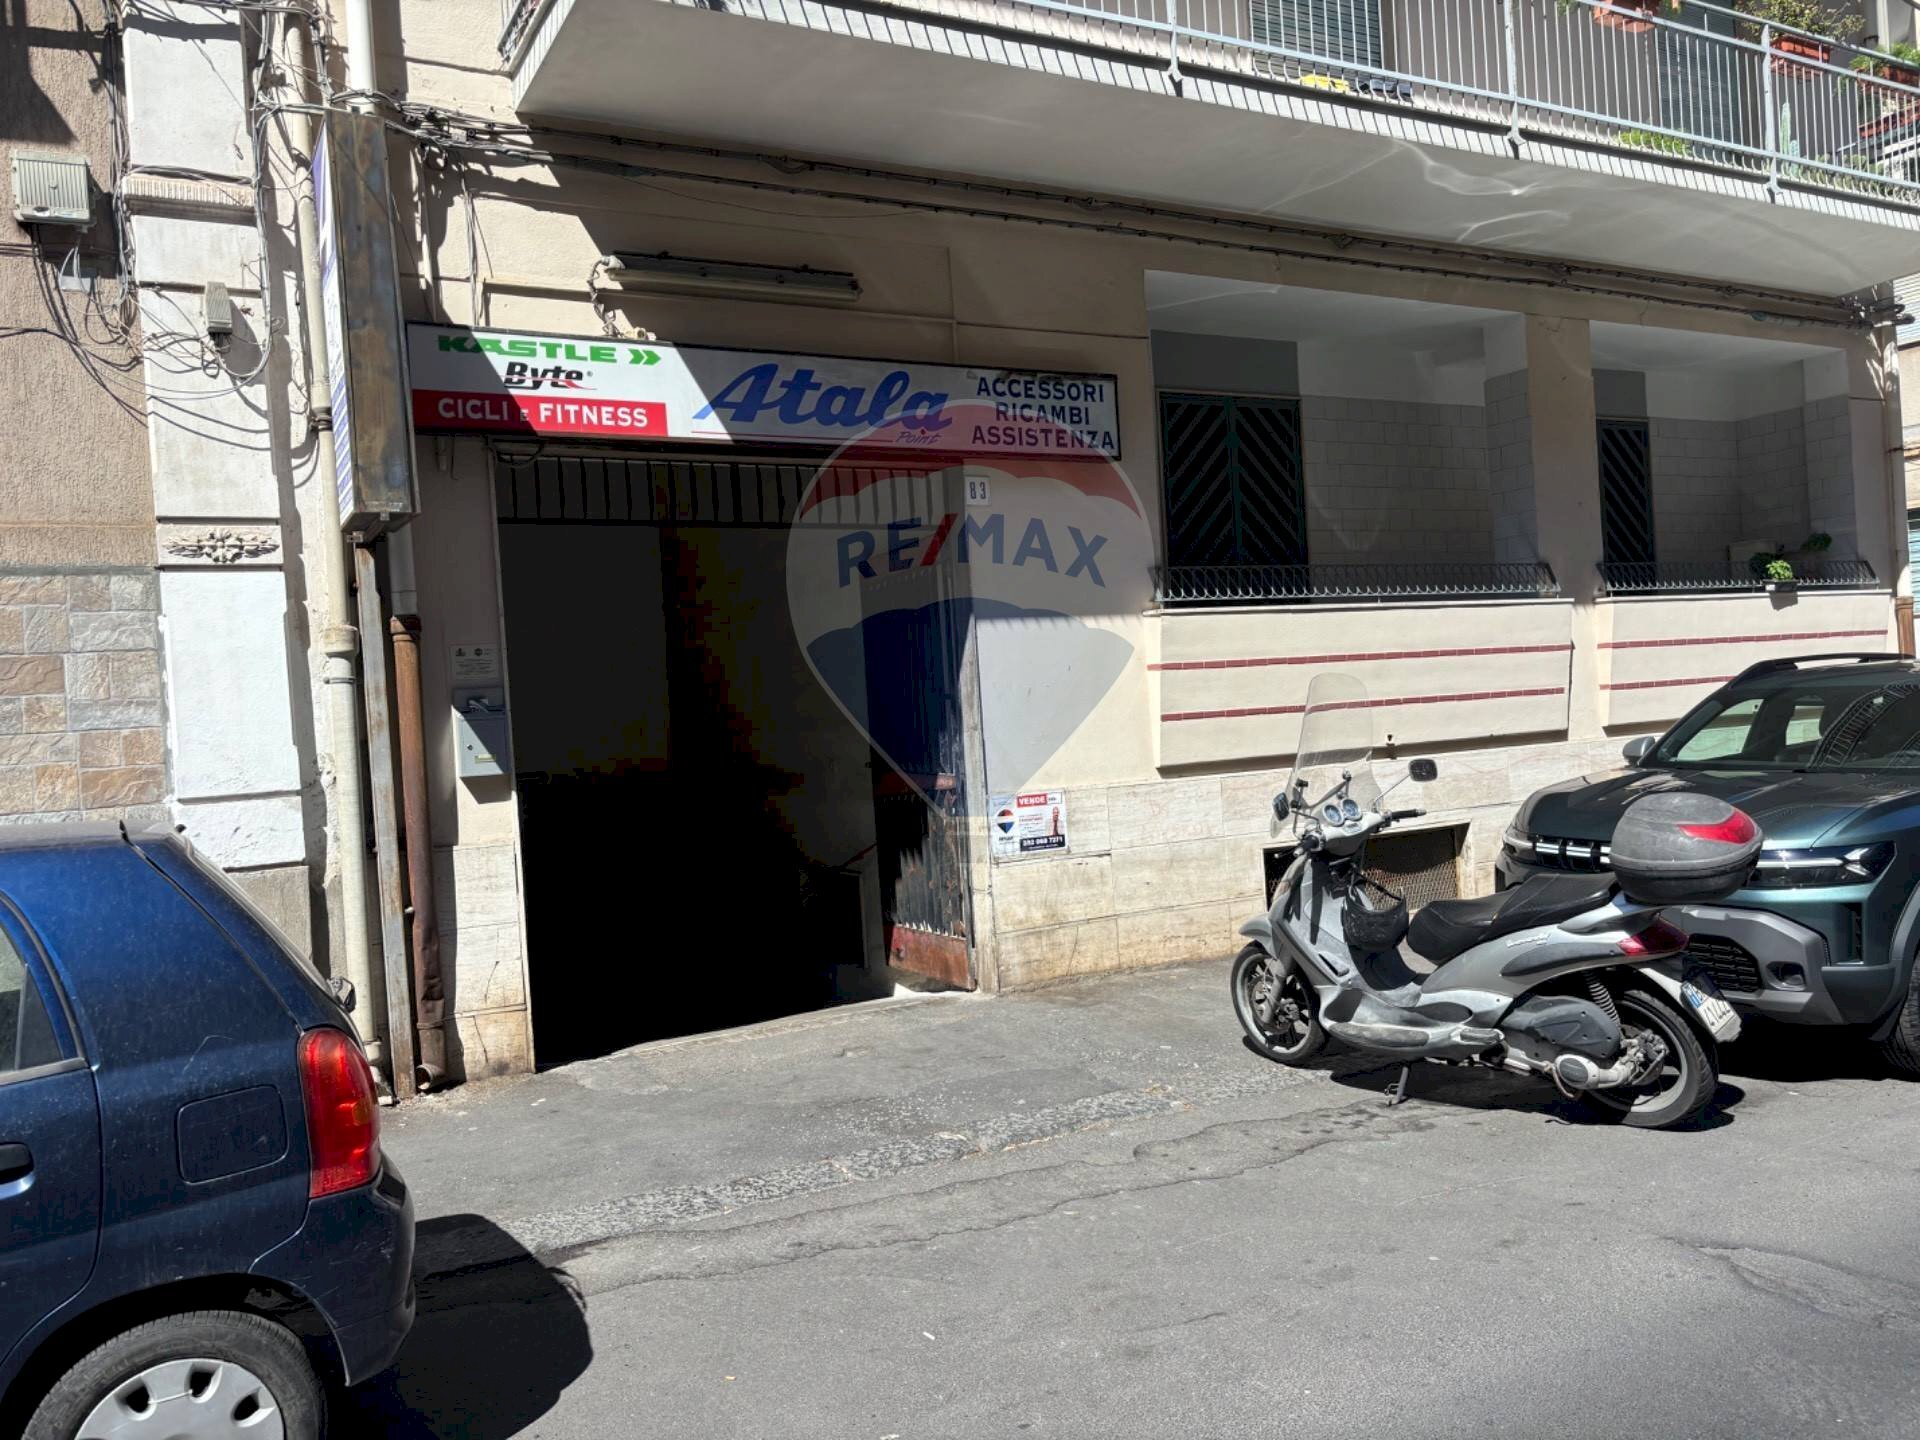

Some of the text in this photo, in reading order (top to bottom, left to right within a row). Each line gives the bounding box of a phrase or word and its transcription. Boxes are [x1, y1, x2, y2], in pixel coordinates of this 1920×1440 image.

[504, 362, 583, 390] Byte
[692, 363, 953, 430] Atala
[976, 376, 1105, 402] ACCESSORI
[438, 397, 508, 422] CICLI
[539, 403, 648, 428] FITNESS
[995, 401, 1090, 426] RICAMBI
[972, 427, 1115, 450] ASSISTENZA
[969, 481, 986, 499] 83
[1018, 796, 1046, 805] VENDE
